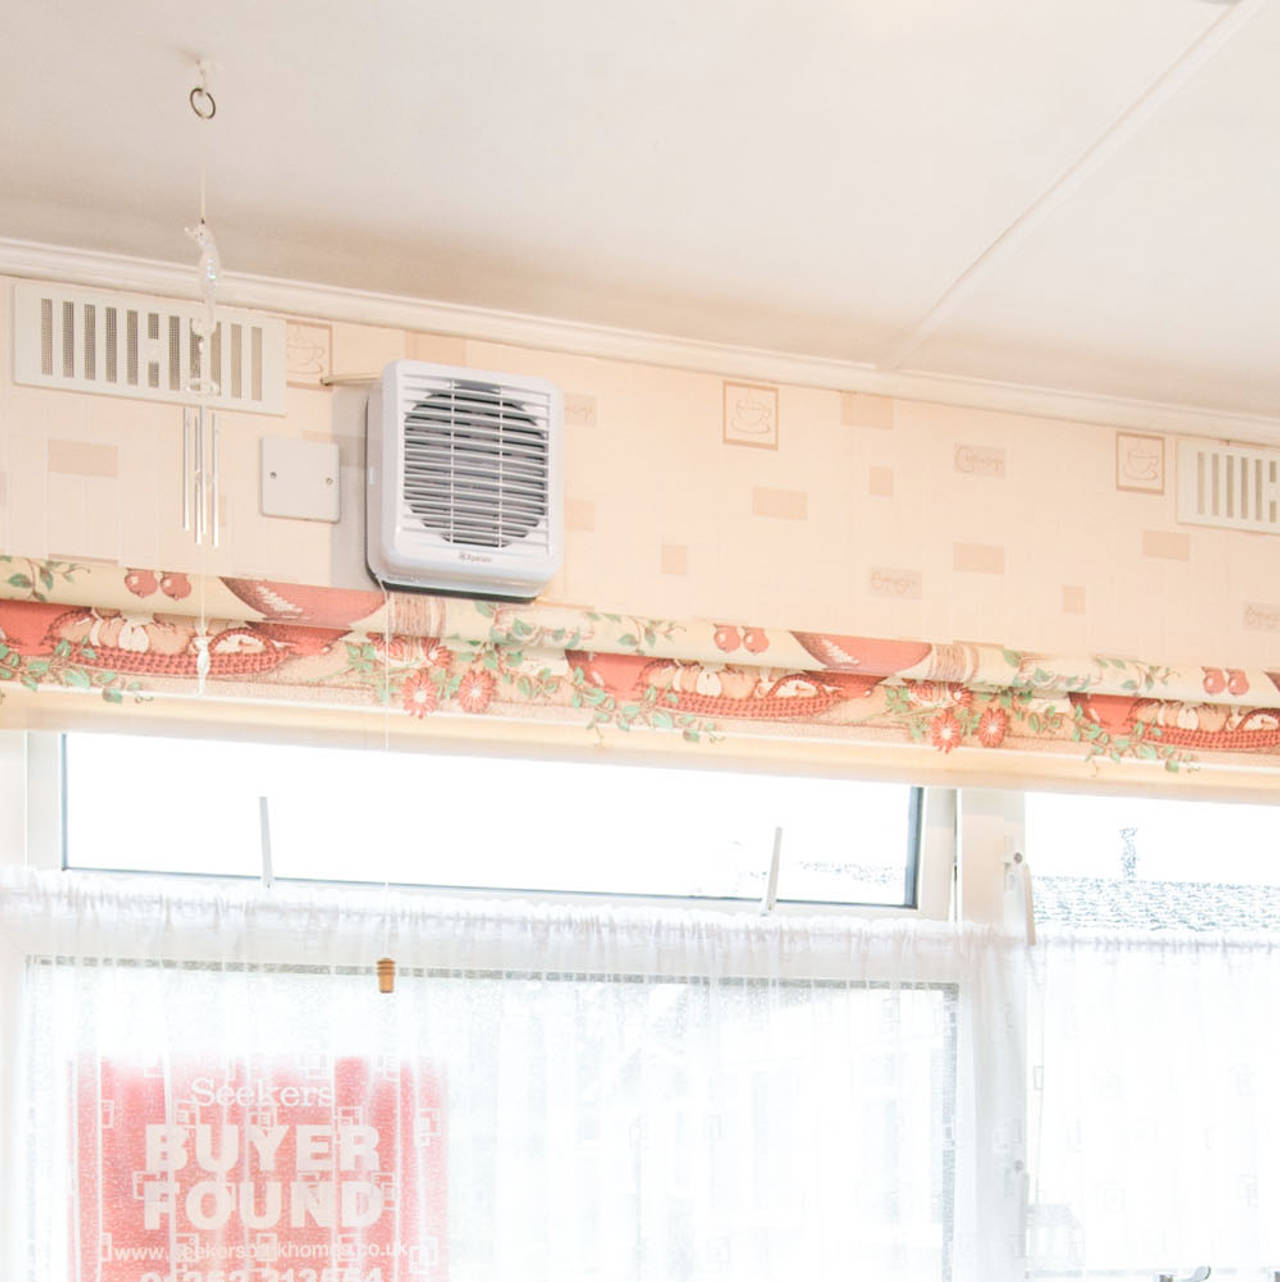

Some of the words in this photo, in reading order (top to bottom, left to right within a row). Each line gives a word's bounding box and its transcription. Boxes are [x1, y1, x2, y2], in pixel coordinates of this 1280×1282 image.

[191, 1077, 335, 1108] Seekers
[145, 1123, 381, 1172] BUYER
[143, 1180, 384, 1231] FOUND
